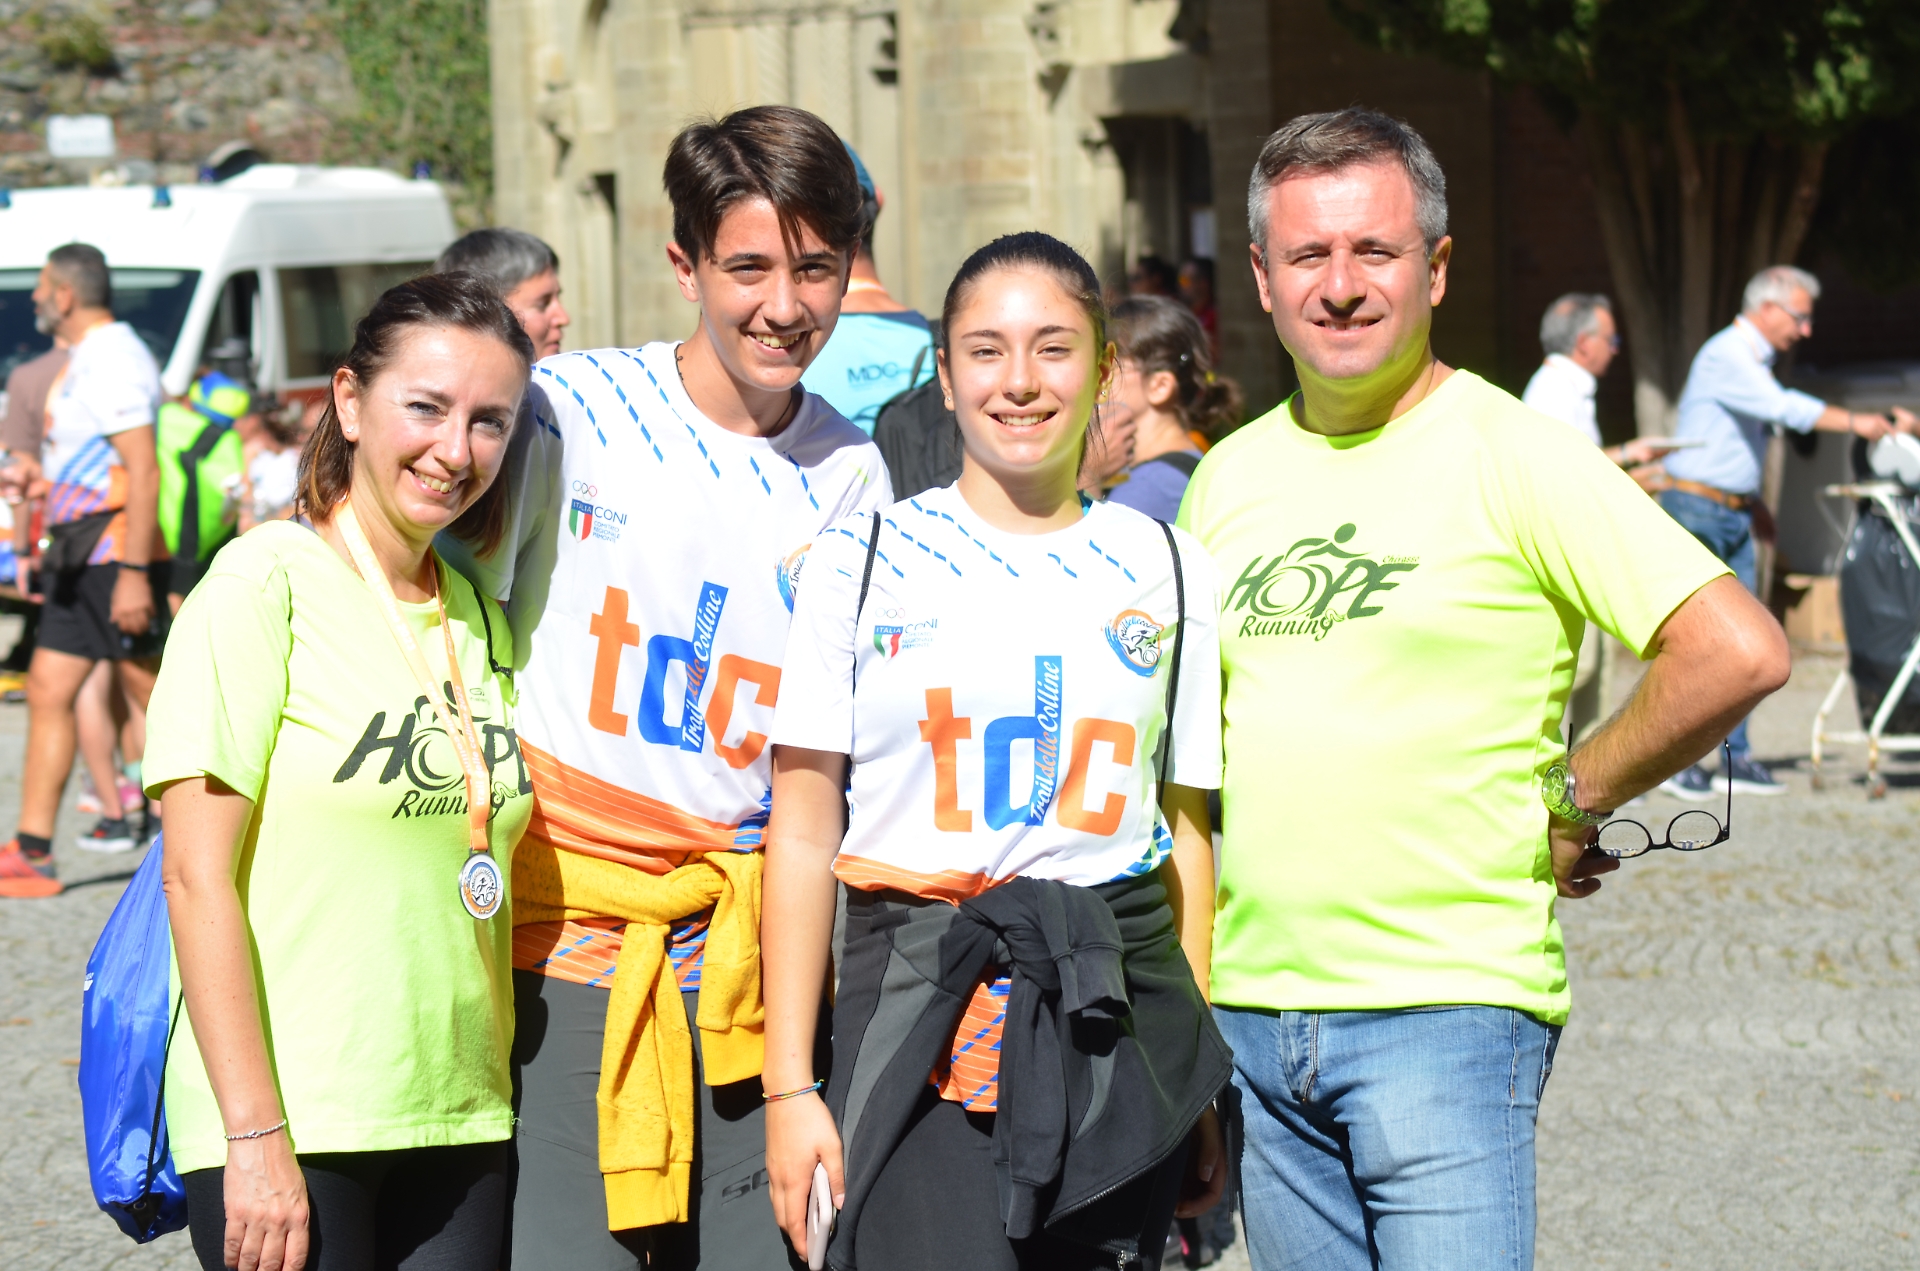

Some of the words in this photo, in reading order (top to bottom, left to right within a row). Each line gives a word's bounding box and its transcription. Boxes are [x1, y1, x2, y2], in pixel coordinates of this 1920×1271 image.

[573, 501, 592, 513] ITALIA
[594, 506, 628, 526] CONI
[1222, 554, 1420, 620] HOPE
[876, 626, 902, 634] ITALIA
[1238, 613, 1334, 642] Running
[917, 655, 1136, 837] tdc
[392, 788, 506, 822] Runnig
